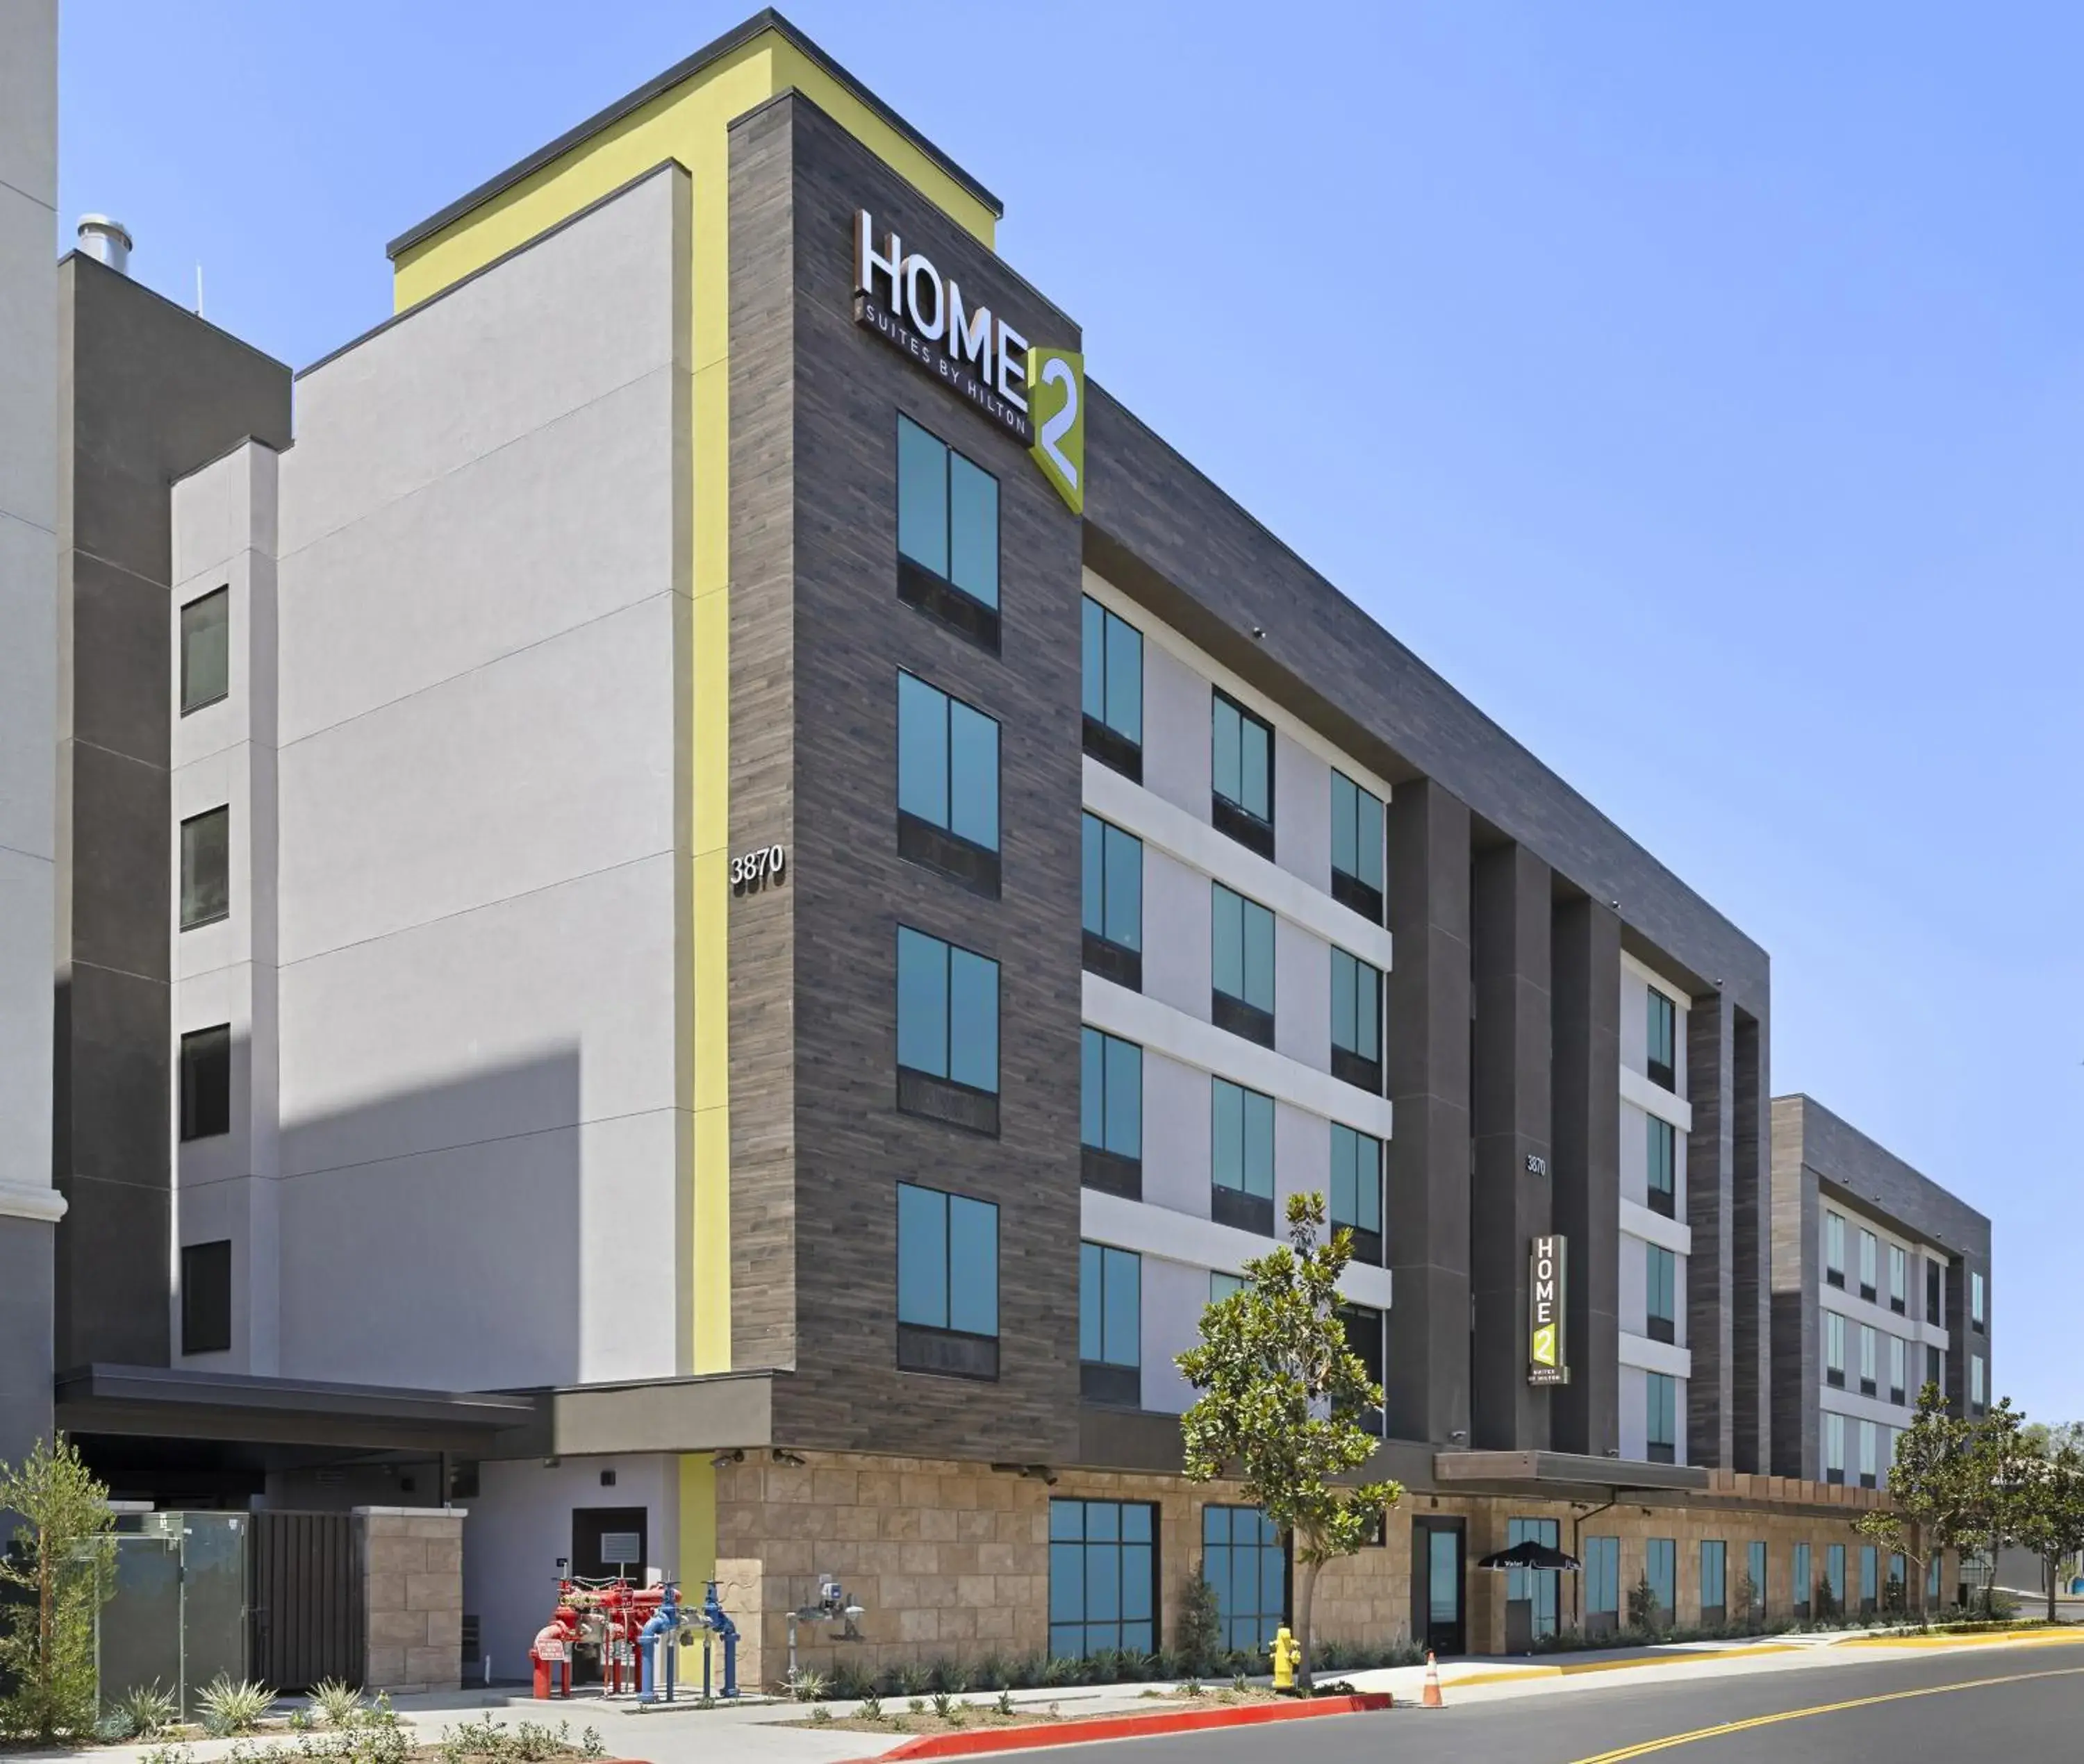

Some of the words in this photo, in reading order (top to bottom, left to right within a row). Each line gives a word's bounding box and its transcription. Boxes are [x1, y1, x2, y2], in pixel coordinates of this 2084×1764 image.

[857, 208, 1028, 413] HOME
[1041, 357, 1077, 490] 2
[866, 304, 931, 363] SUITES
[939, 358, 960, 383] BY
[968, 380, 1025, 434] HILTON
[730, 844, 784, 884] 3870
[1528, 1154, 1546, 1176] 3870
[1536, 1237, 1553, 1323] HOME
[1537, 1329, 1553, 1361] 2
